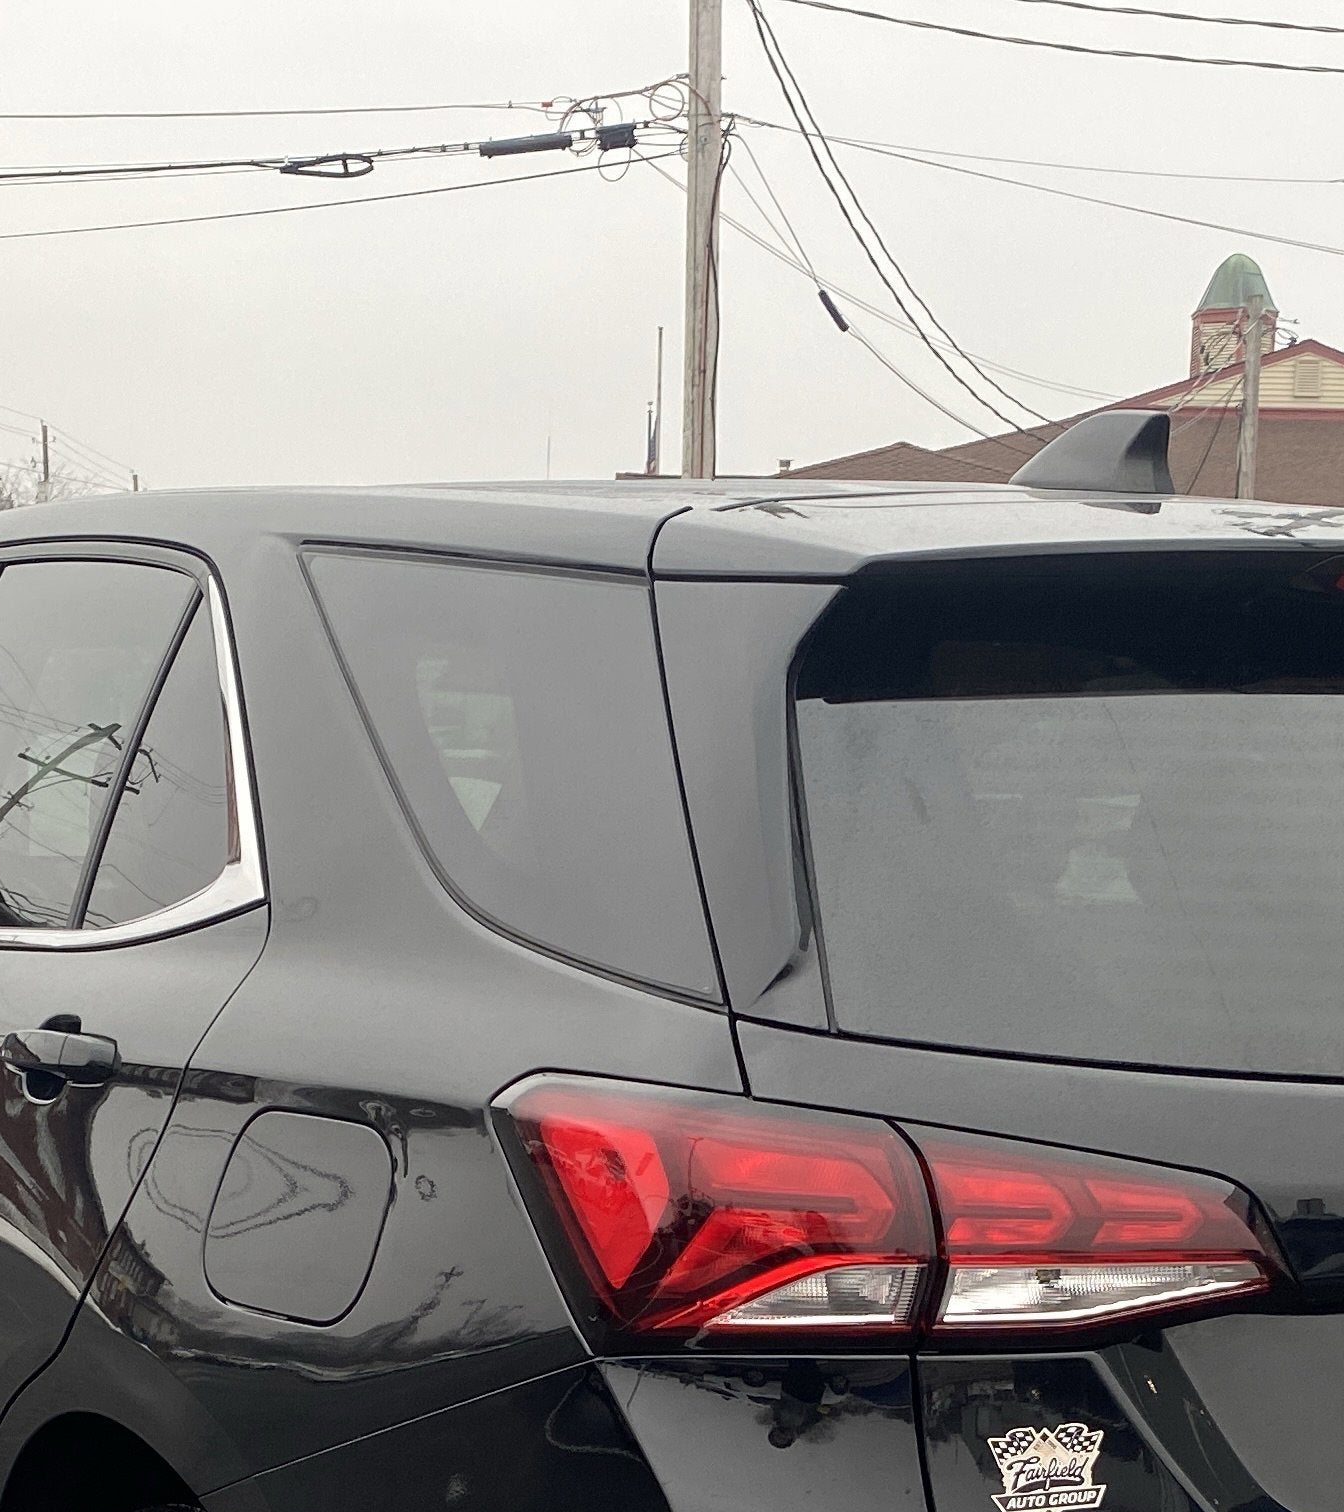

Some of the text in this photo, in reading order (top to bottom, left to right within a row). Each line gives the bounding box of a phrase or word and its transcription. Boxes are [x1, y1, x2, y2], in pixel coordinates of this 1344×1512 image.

[1006, 1456, 1090, 1493] Fairfield
[1006, 1491, 1097, 1510] AUTO GROUP
